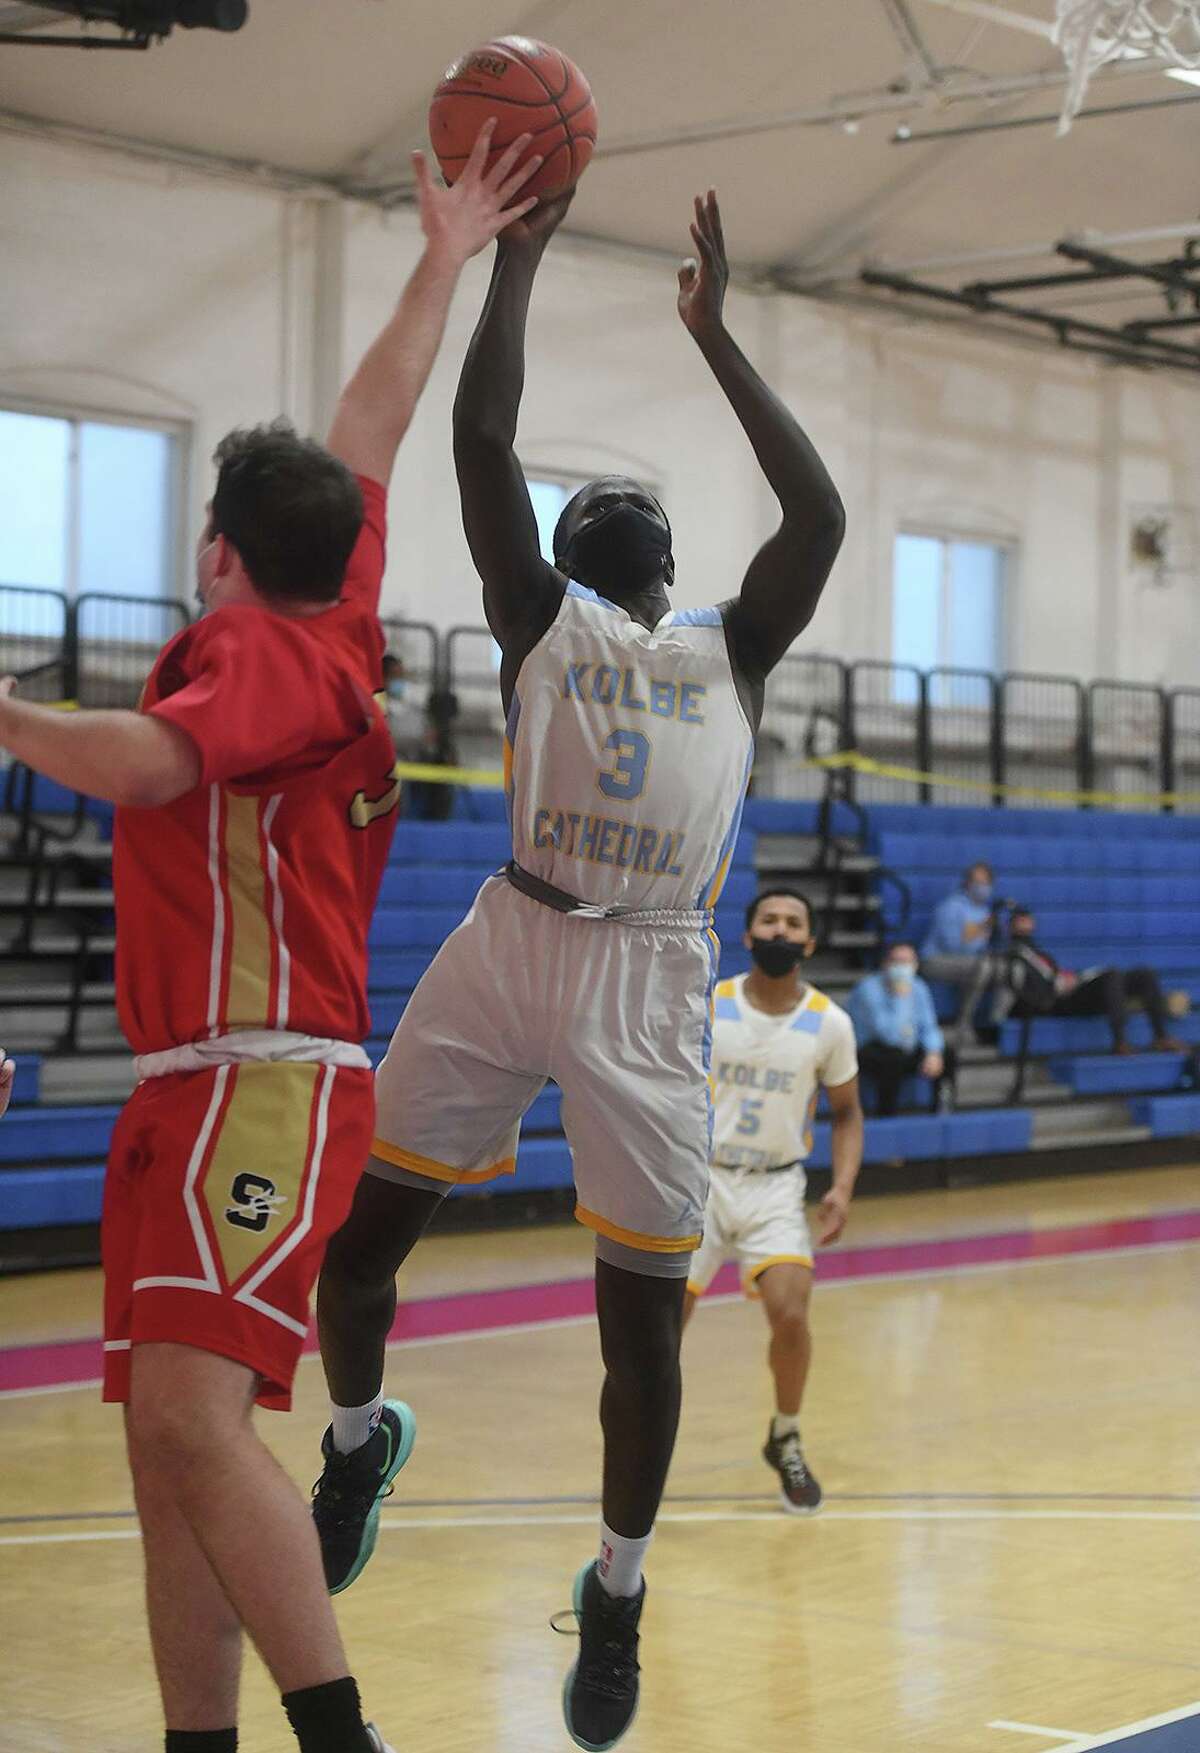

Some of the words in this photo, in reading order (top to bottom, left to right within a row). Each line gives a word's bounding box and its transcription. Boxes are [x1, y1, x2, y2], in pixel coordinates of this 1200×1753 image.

[563, 661, 707, 725] KOLBE
[597, 727, 653, 801] 3
[735, 1098, 764, 1136] 5
